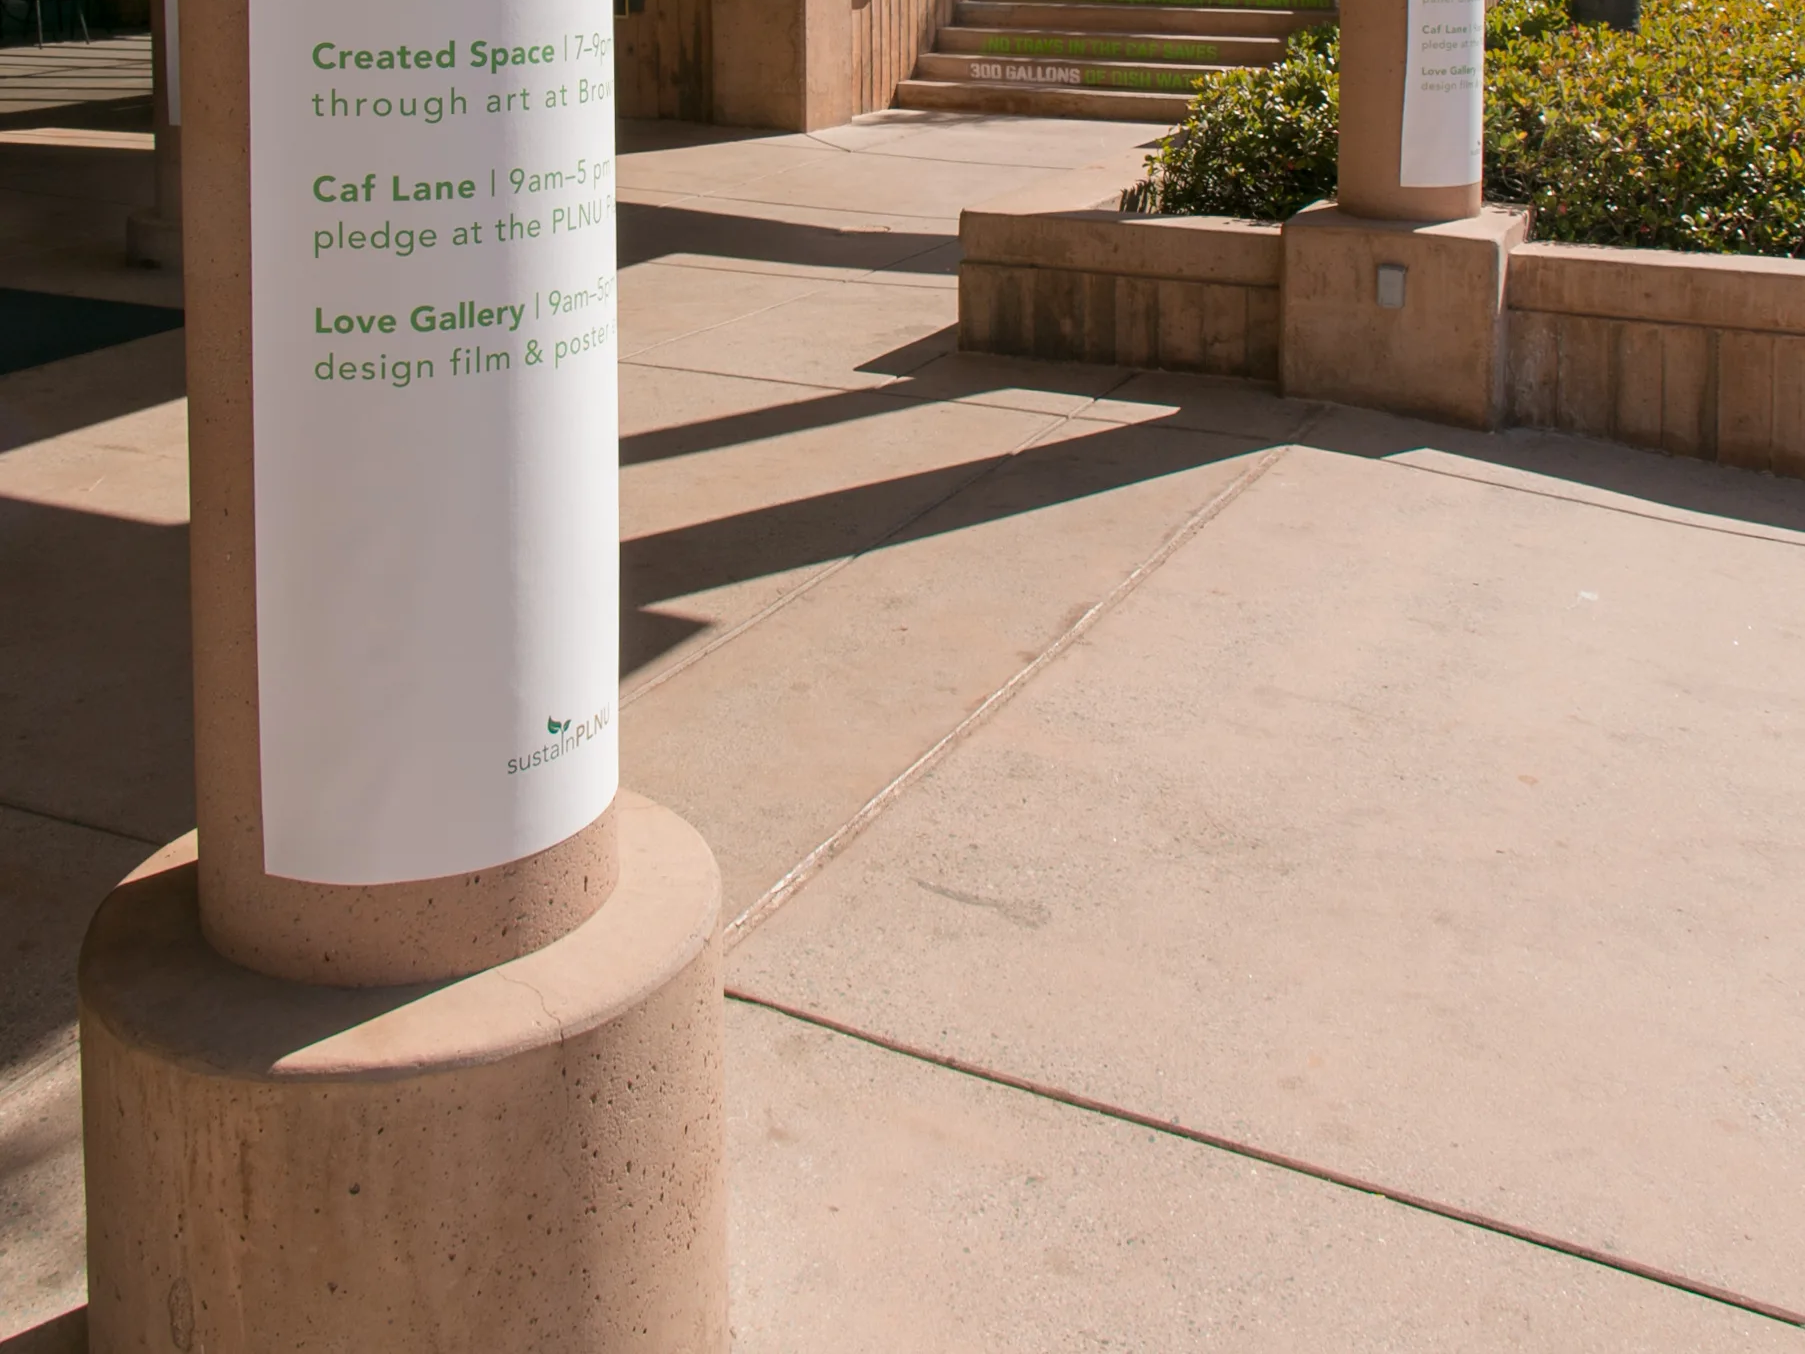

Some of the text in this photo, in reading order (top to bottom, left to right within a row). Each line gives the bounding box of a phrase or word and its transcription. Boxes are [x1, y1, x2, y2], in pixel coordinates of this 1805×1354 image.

[988, 36, 1011, 52] NO
[1015, 37, 1063, 54] TRAYS
[1067, 39, 1085, 55] IN
[1091, 40, 1121, 57] THE
[1162, 42, 1218, 60] SAVES
[1422, 24, 1442, 35] Caf
[1446, 24, 1468, 34] Lane
[312, 40, 456, 70] Created
[470, 40, 555, 74] Space
[574, 32, 612, 66] 7-9p
[1421, 67, 1448, 76] Love
[970, 62, 1001, 80] 300
[1005, 65, 1082, 84] GALLONS
[1085, 69, 1106, 84] OF
[1111, 70, 1151, 87] DISH
[312, 87, 467, 124] through
[486, 88, 530, 113] art
[545, 84, 568, 108] at
[313, 173, 376, 202] Caf
[393, 175, 476, 201] Lane
[593, 159, 610, 191] pm
[314, 221, 437, 258] pledge
[452, 221, 483, 246] at
[495, 213, 541, 243] the
[553, 198, 602, 234] PLNU
[315, 307, 397, 334] Love
[410, 300, 525, 332] Gallery
[314, 352, 434, 388] design
[450, 346, 510, 376] film
[525, 338, 544, 366] &
[555, 323, 609, 369] poster
[507, 701, 610, 775] sustainPLNU
